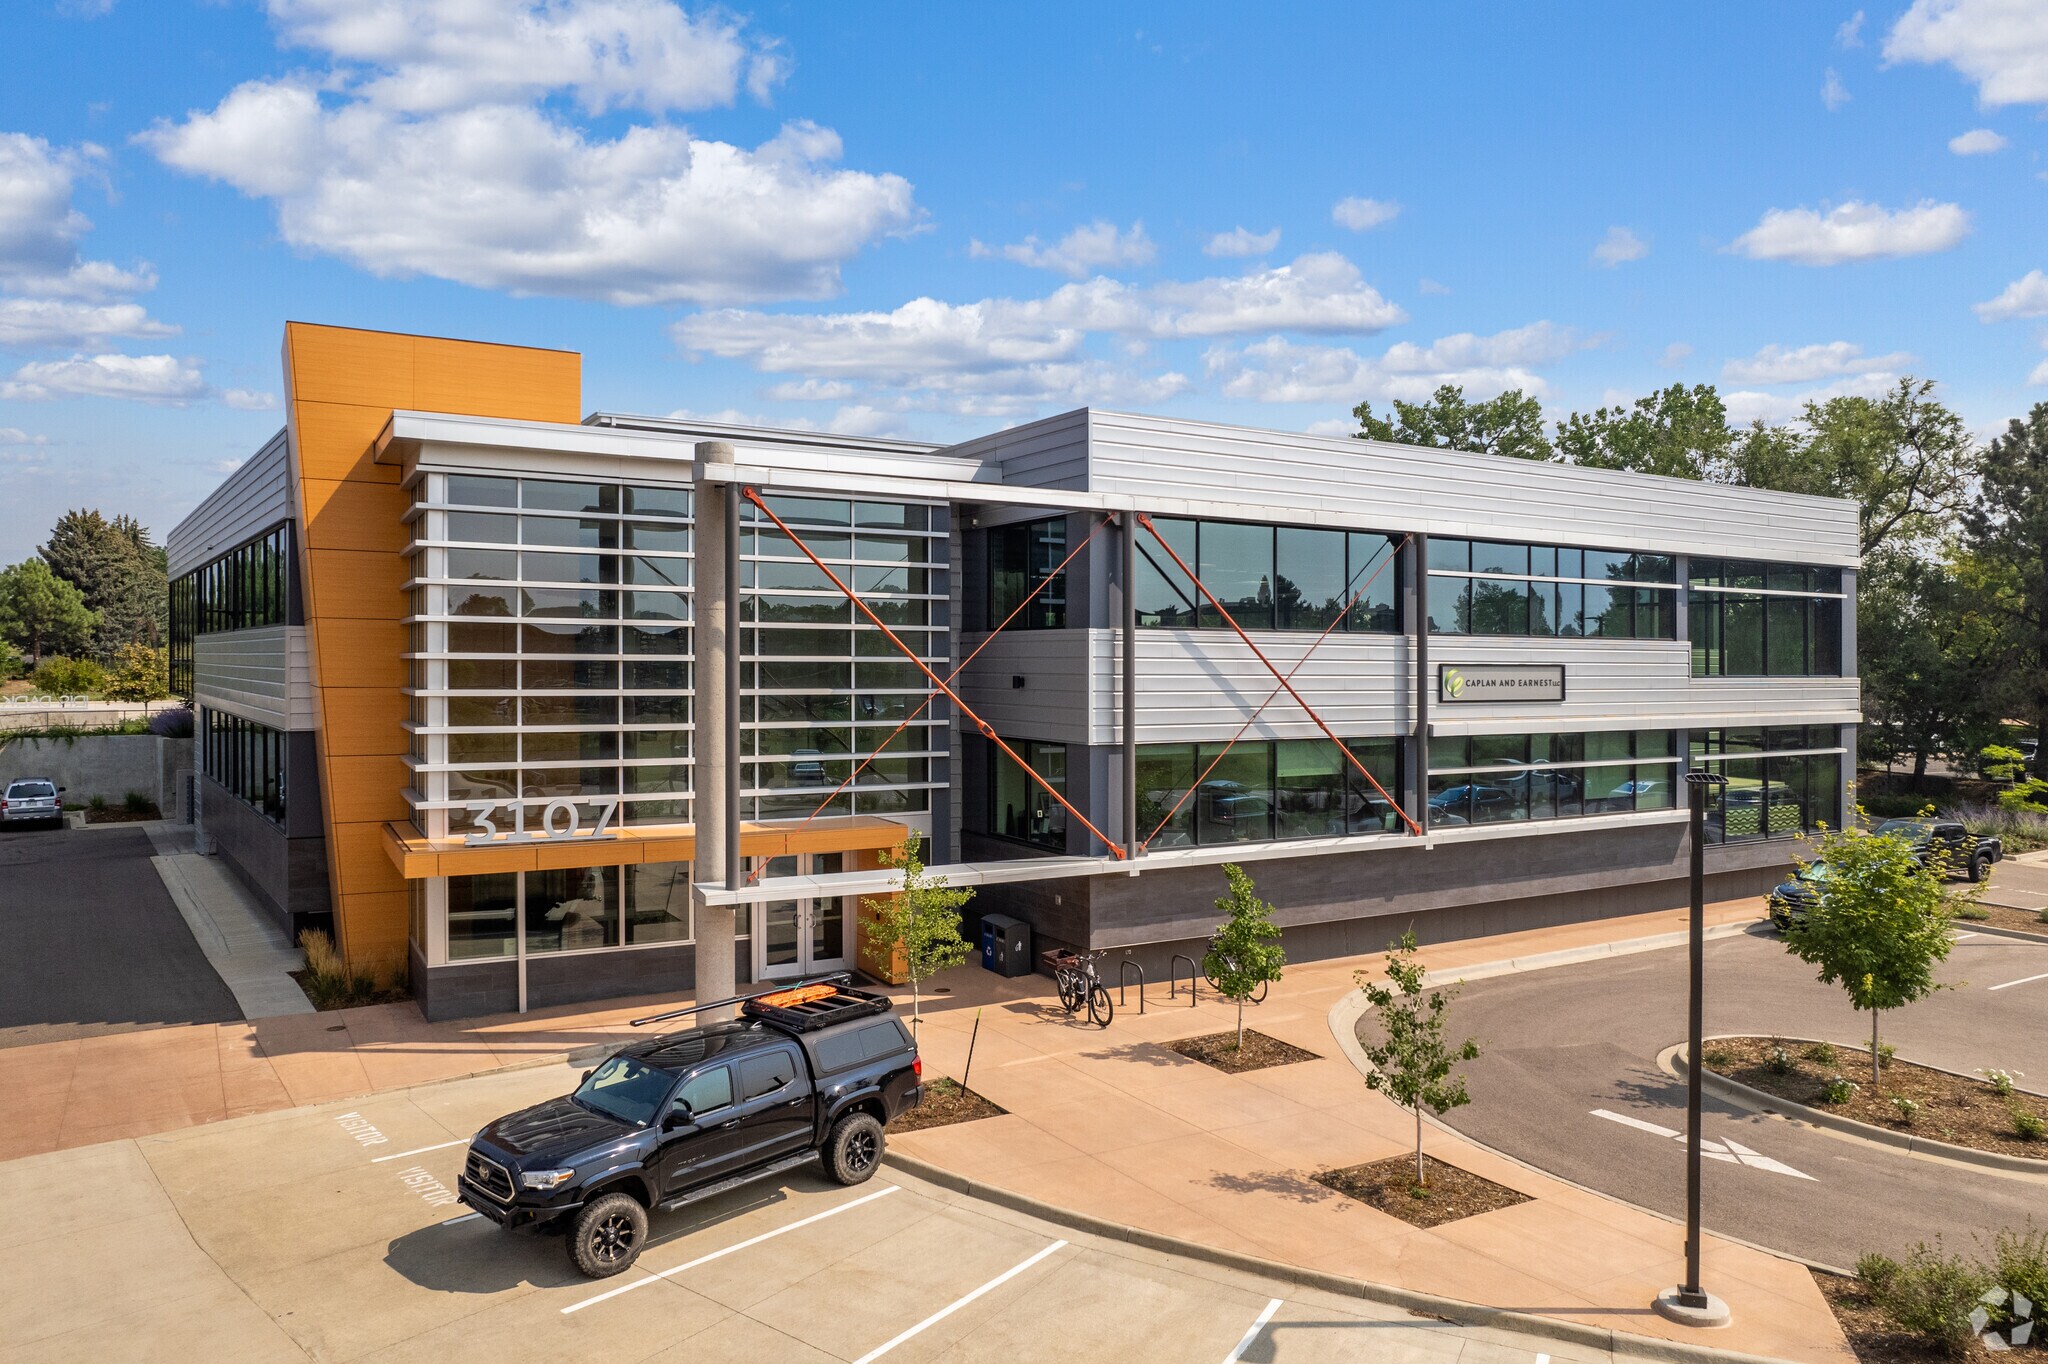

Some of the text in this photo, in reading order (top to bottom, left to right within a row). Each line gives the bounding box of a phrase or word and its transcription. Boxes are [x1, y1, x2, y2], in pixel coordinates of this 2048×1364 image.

[1465, 679, 1497, 688] CAPLAN
[1499, 679, 1516, 687] AND
[1518, 679, 1553, 687] EARNEST
[465, 799, 618, 842] 3107
[333, 1111, 389, 1147] VISITOR
[396, 1165, 458, 1208] VISITOR
